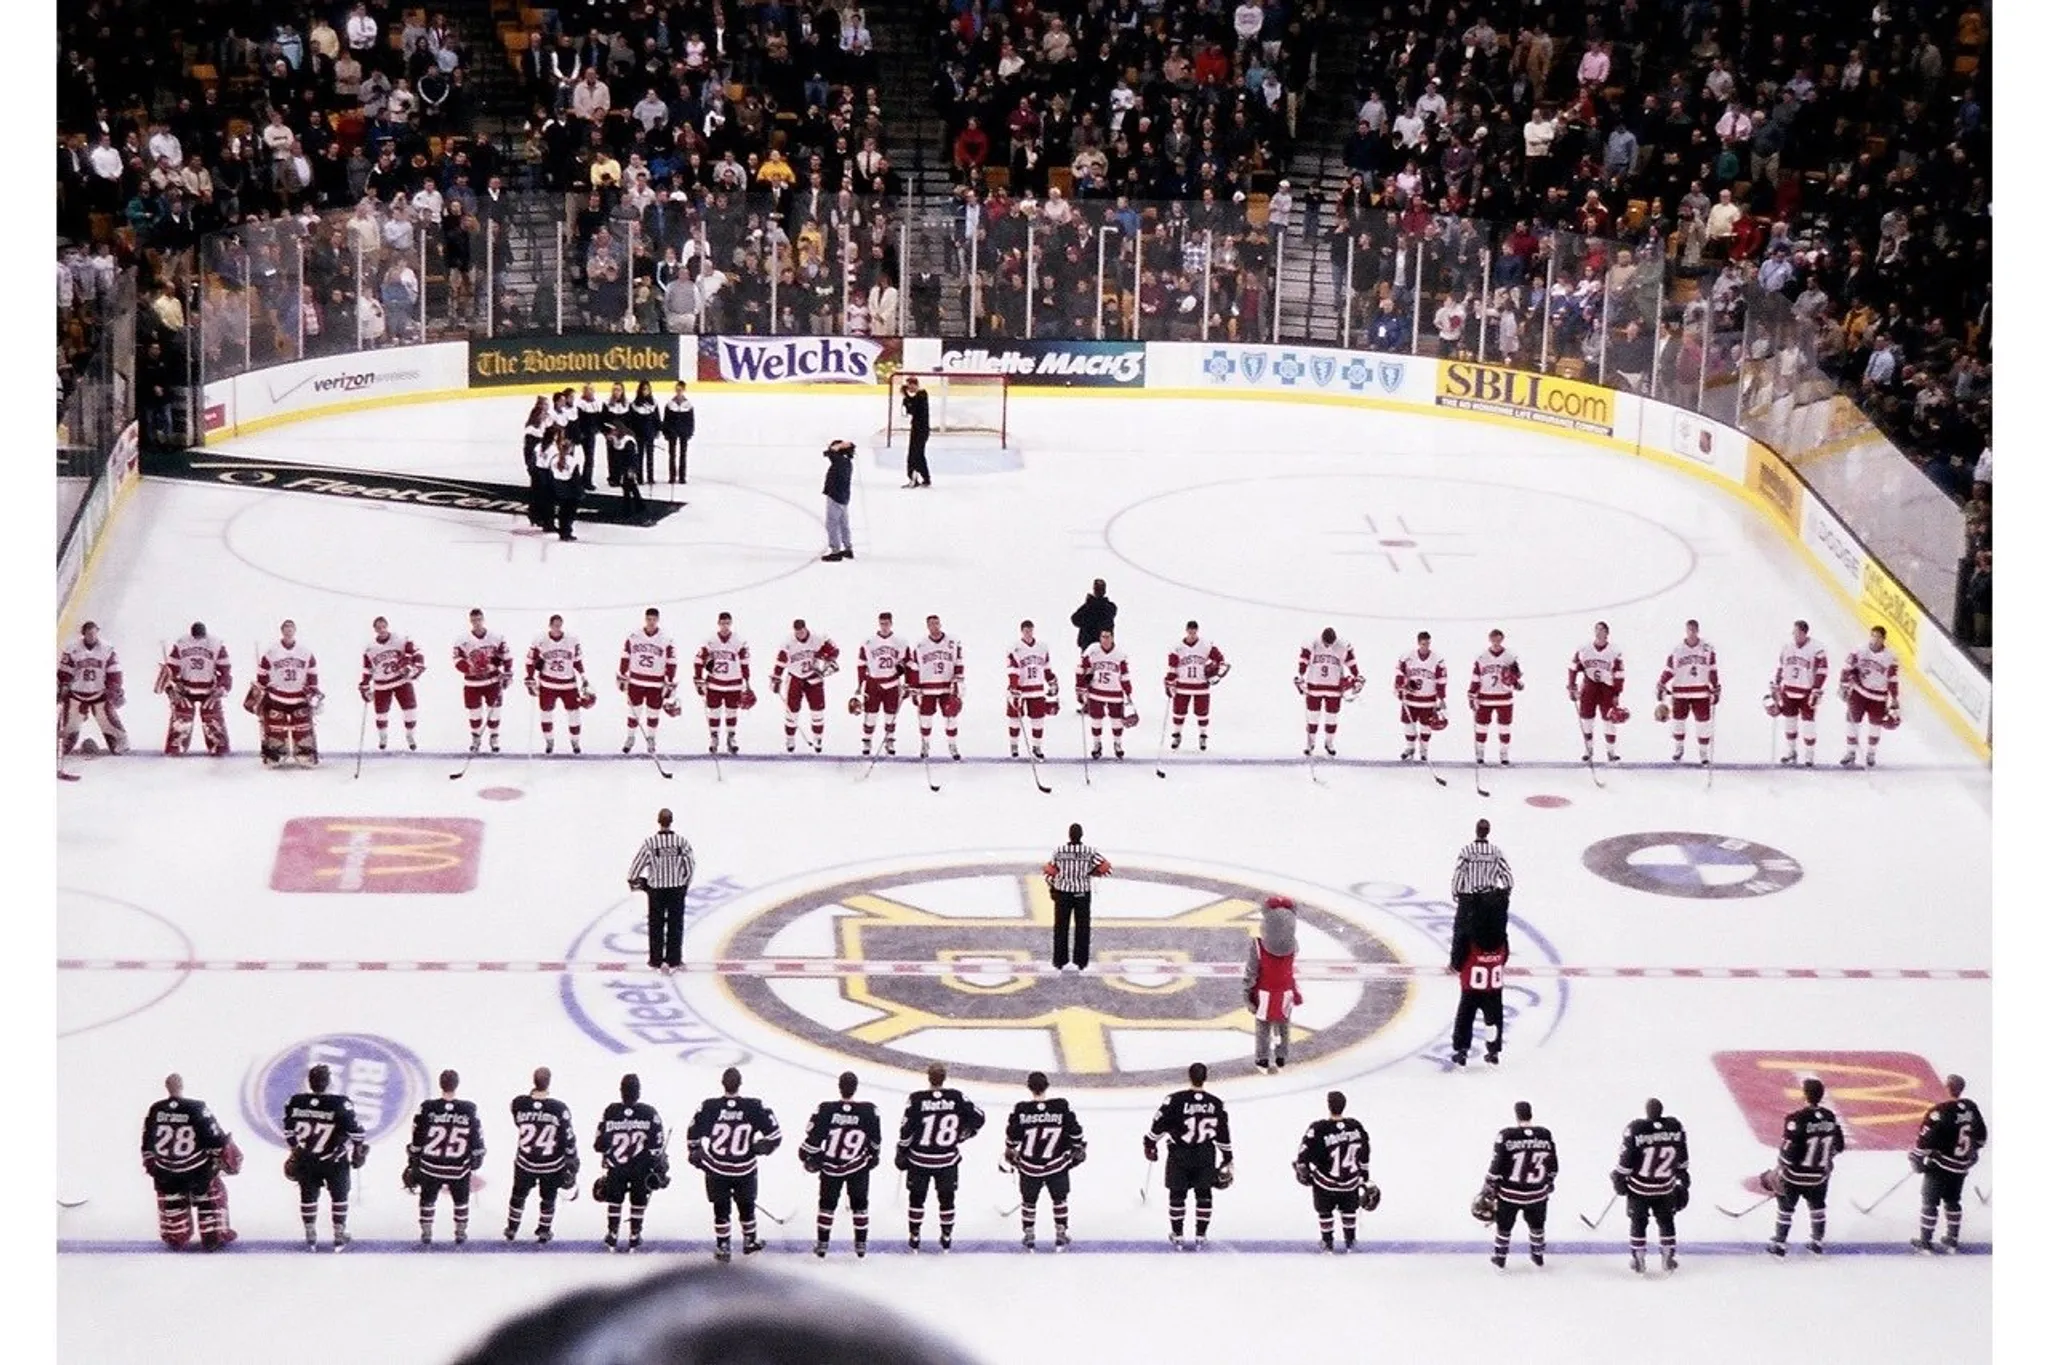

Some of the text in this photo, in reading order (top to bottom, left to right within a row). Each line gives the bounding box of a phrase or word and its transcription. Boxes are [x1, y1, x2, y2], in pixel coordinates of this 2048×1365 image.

[477, 345, 670, 376] The Boston Globe
[724, 340, 869, 383] Welch's
[942, 349, 1144, 382] Gillette MACH3
[314, 371, 375, 391] verizon
[1446, 363, 1608, 422] SBLI.com
[639, 655, 654, 668] 25
[713, 661, 729, 673] 23
[878, 657, 893, 670] 20
[1099, 671, 1110, 684] 15
[1186, 666, 1197, 678] 11
[1321, 665, 1329, 678] 9
[1183, 1102, 1215, 1116] Lynch
[154, 1125, 196, 1157] 28
[294, 1122, 334, 1154] 27
[423, 1126, 470, 1157] 25
[519, 1123, 557, 1156] 24
[711, 1123, 752, 1156] 20
[825, 1128, 866, 1160] 19
[919, 1114, 960, 1147] 18
[1022, 1127, 1062, 1159] 17
[1181, 1117, 1218, 1144] 16
[1953, 1125, 1972, 1157] 5
[1329, 1143, 1361, 1177] 14
[1509, 1151, 1549, 1183] 13
[1640, 1146, 1676, 1178] 12
[1801, 1137, 1834, 1167] 11
